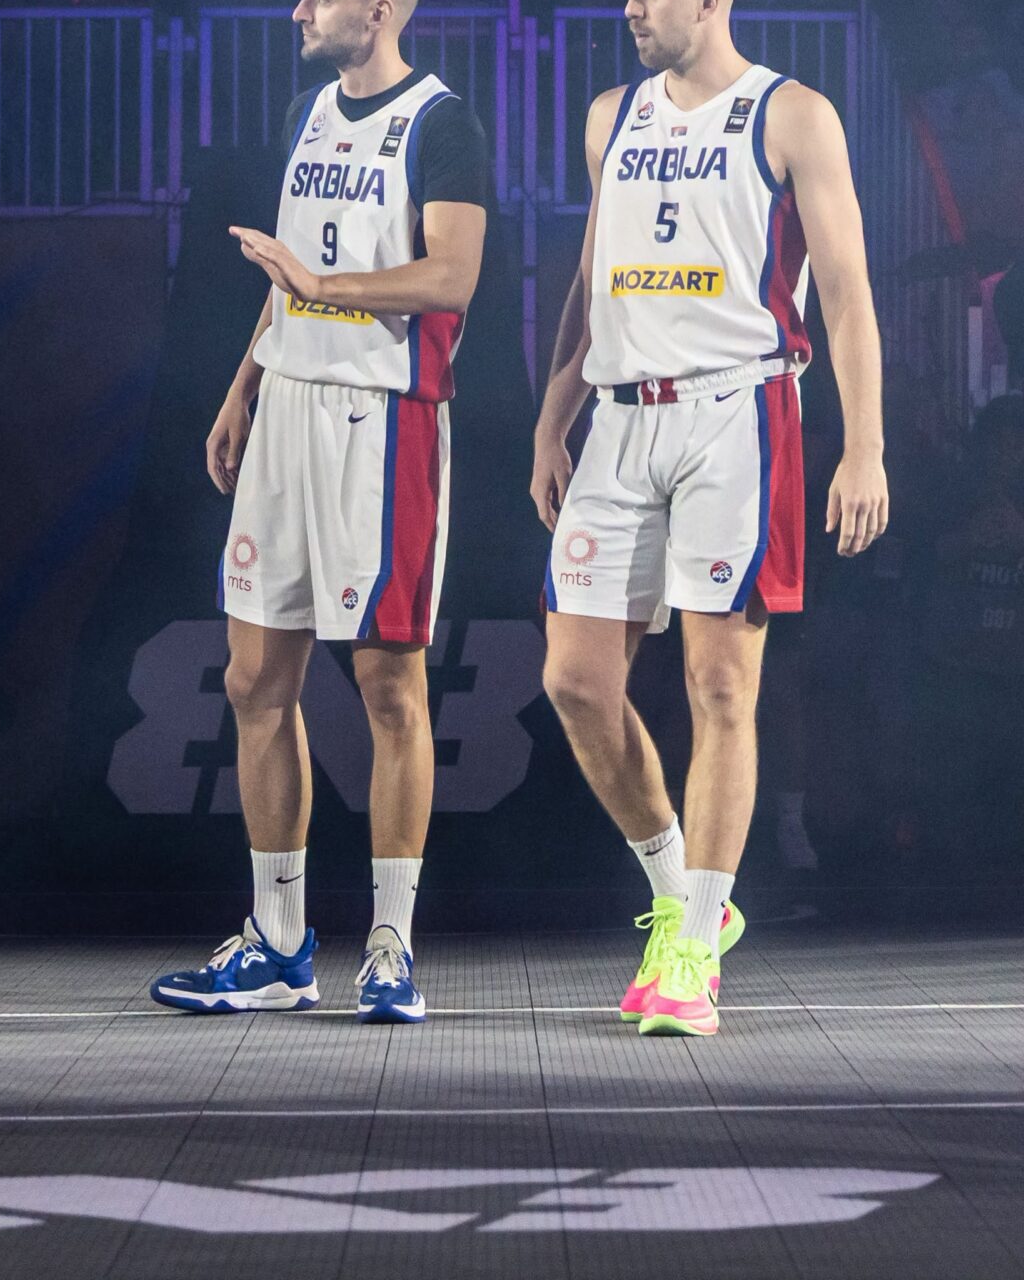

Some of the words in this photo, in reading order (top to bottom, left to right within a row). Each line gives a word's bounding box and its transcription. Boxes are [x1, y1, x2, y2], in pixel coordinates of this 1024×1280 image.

[617, 145, 727, 182] SRBIJA
[290, 162, 385, 206] SRBIJA
[654, 202, 679, 243] 5
[321, 221, 338, 266] 9
[612, 270, 719, 292] MOZZART
[227, 575, 252, 592] mts
[559, 571, 592, 587] mts
